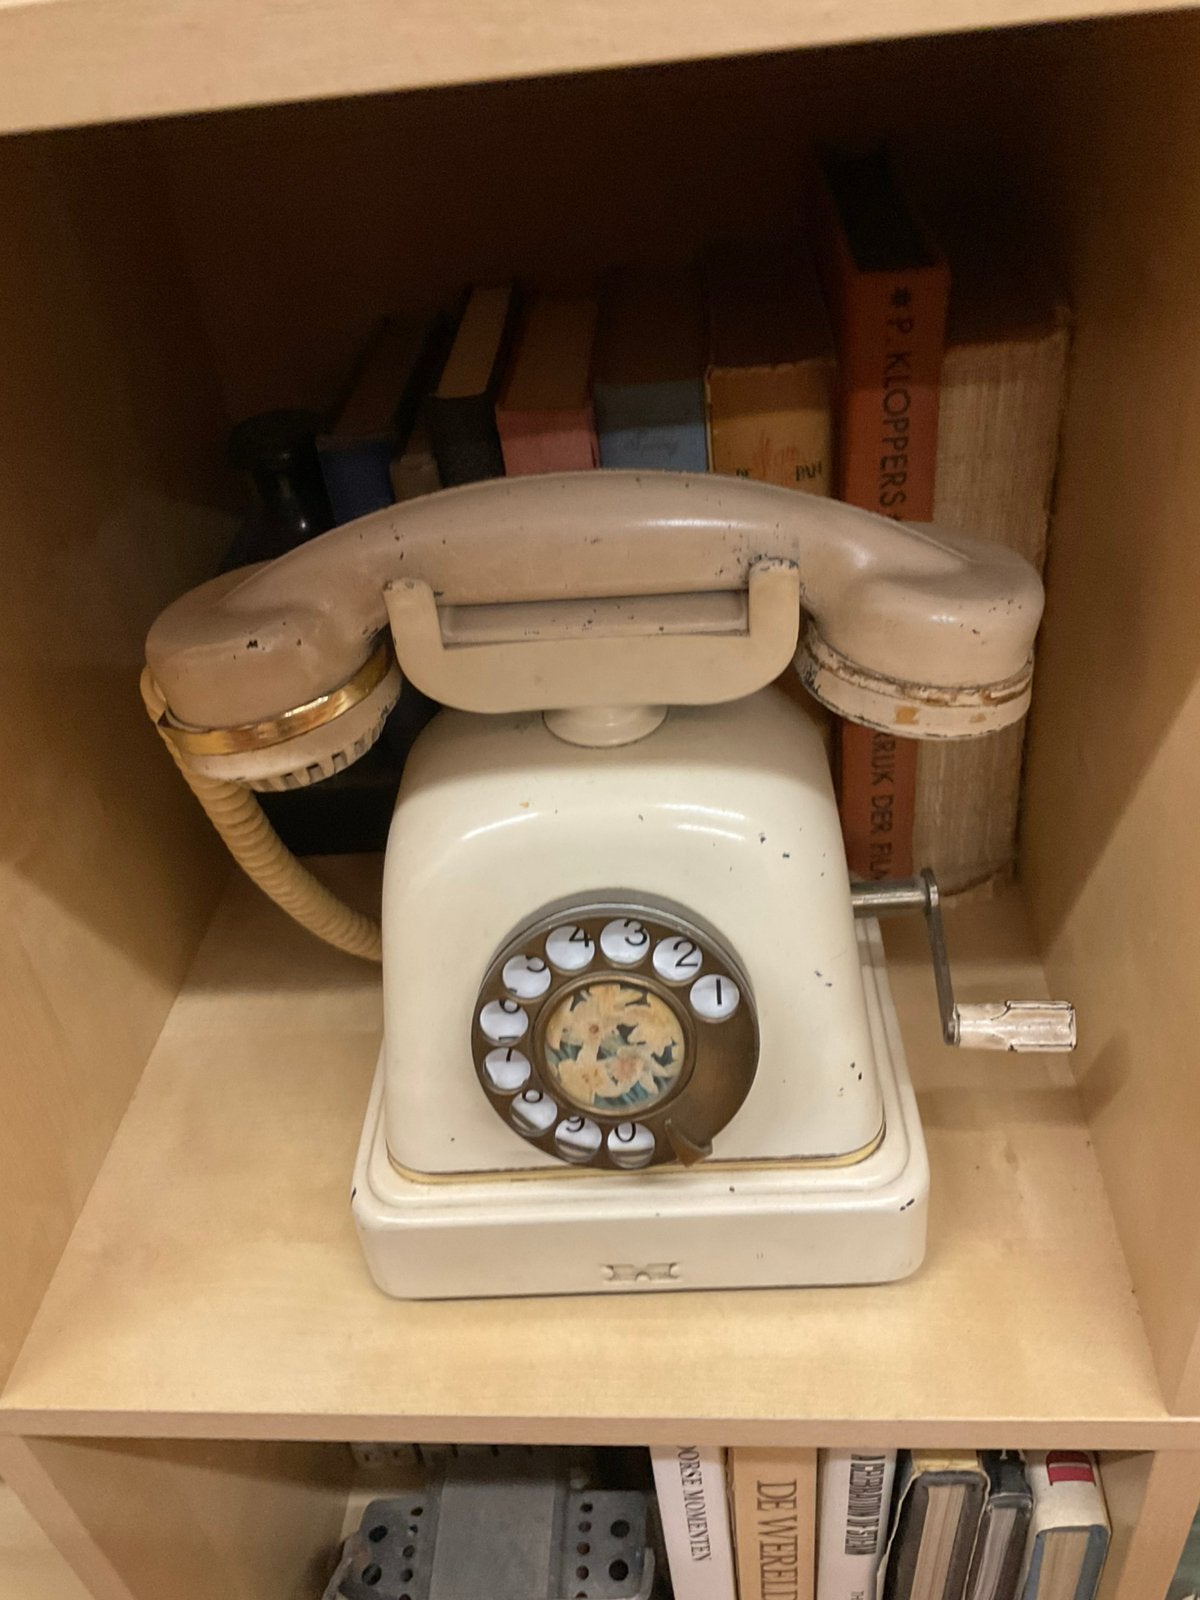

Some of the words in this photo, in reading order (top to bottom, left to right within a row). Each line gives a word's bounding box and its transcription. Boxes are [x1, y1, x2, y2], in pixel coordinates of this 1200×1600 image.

[879, 351, 913, 508] KLOPPERS
[870, 794, 895, 835] DER
[569, 927, 592, 948] 4
[624, 919, 647, 946] 3
[673, 940, 698, 968] 2
[757, 1480, 798, 1511] DE
[683, 1489, 712, 1562] MOMENTEN
